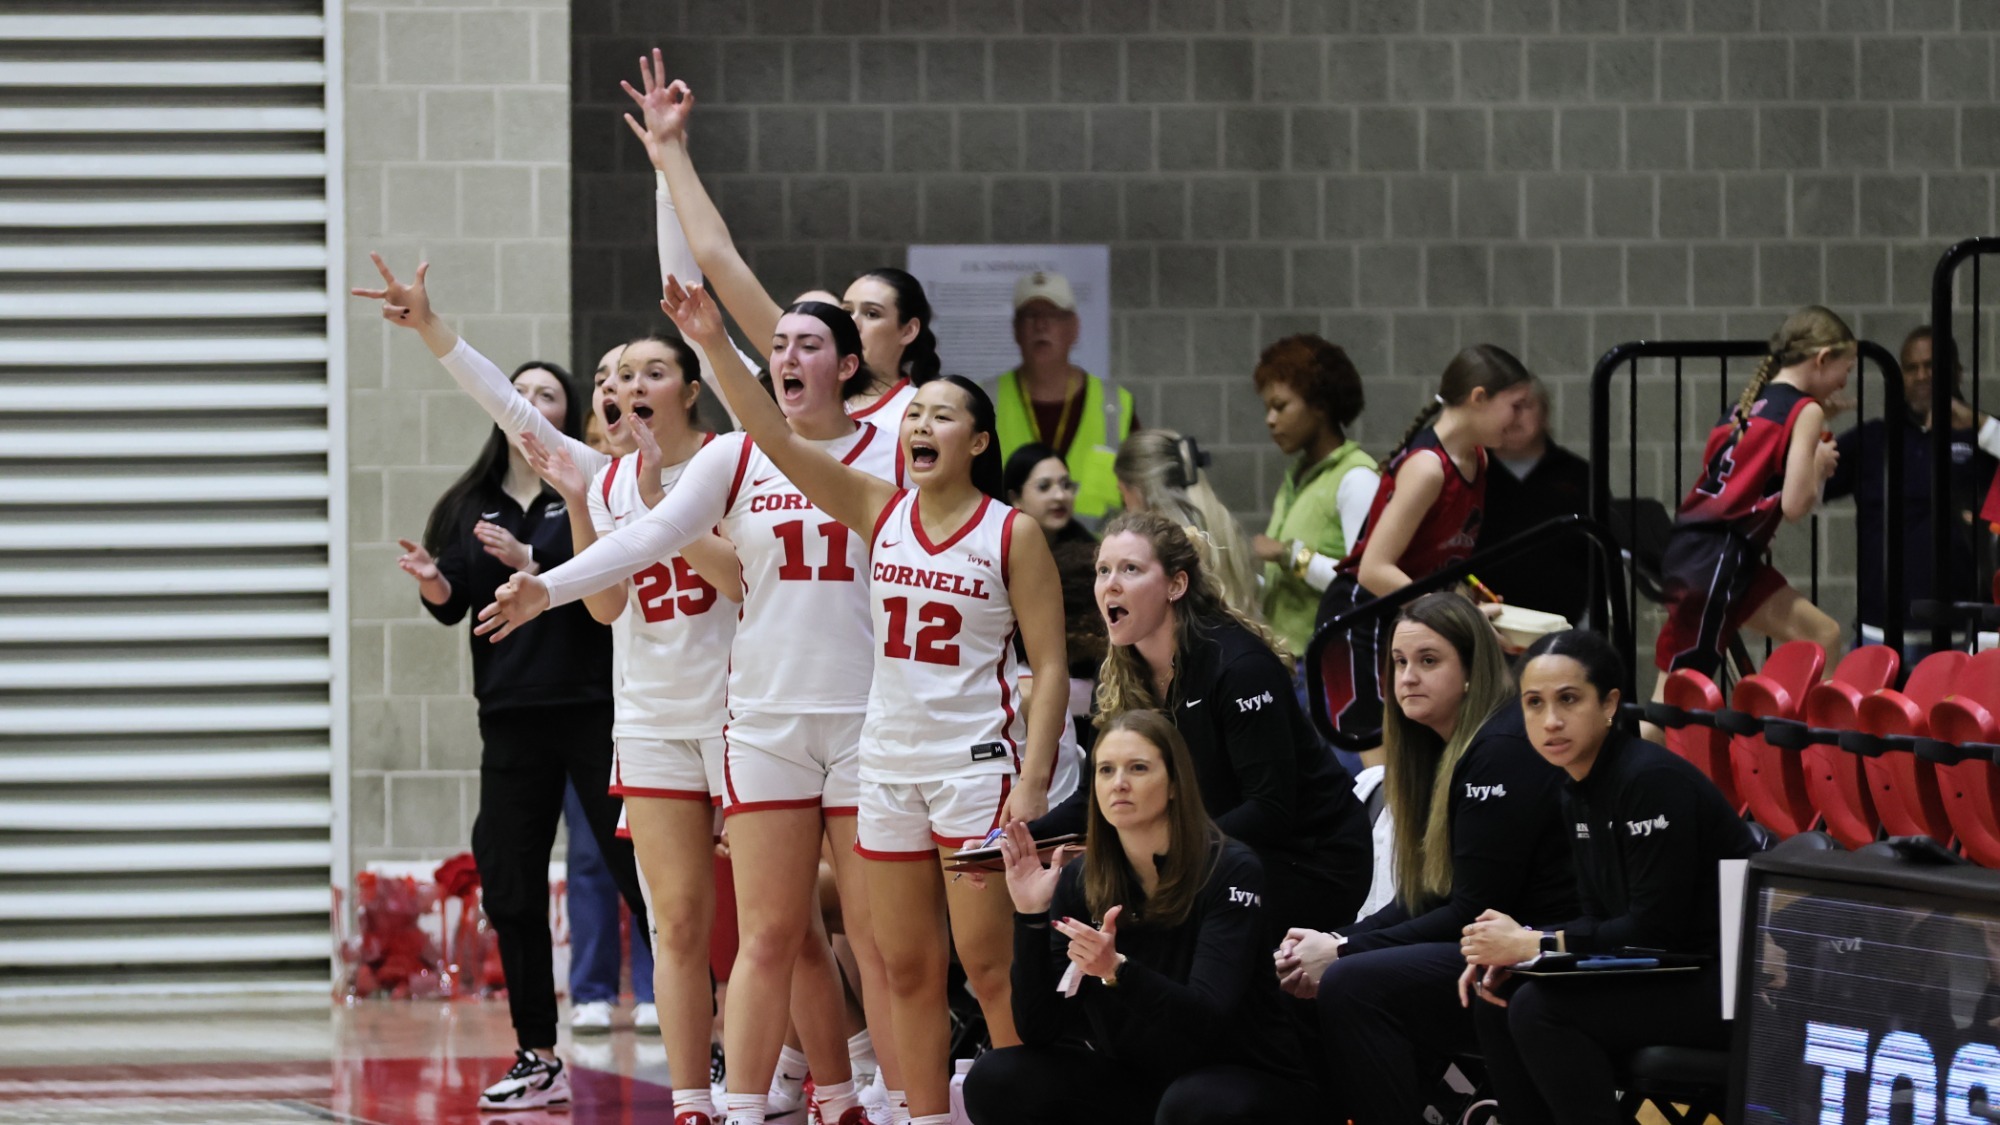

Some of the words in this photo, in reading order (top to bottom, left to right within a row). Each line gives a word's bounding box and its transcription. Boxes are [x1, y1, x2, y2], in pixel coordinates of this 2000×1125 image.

[772, 520, 855, 582] 11
[967, 554, 985, 566] Ivy
[632, 556, 717, 623] 25
[873, 562, 990, 600] CORNELL
[882, 596, 963, 666] 12
[1235, 694, 1262, 712] Ivy
[1465, 782, 1492, 802] Ivy
[1626, 819, 1653, 836] Ivy
[1228, 886, 1254, 907] Ivy
